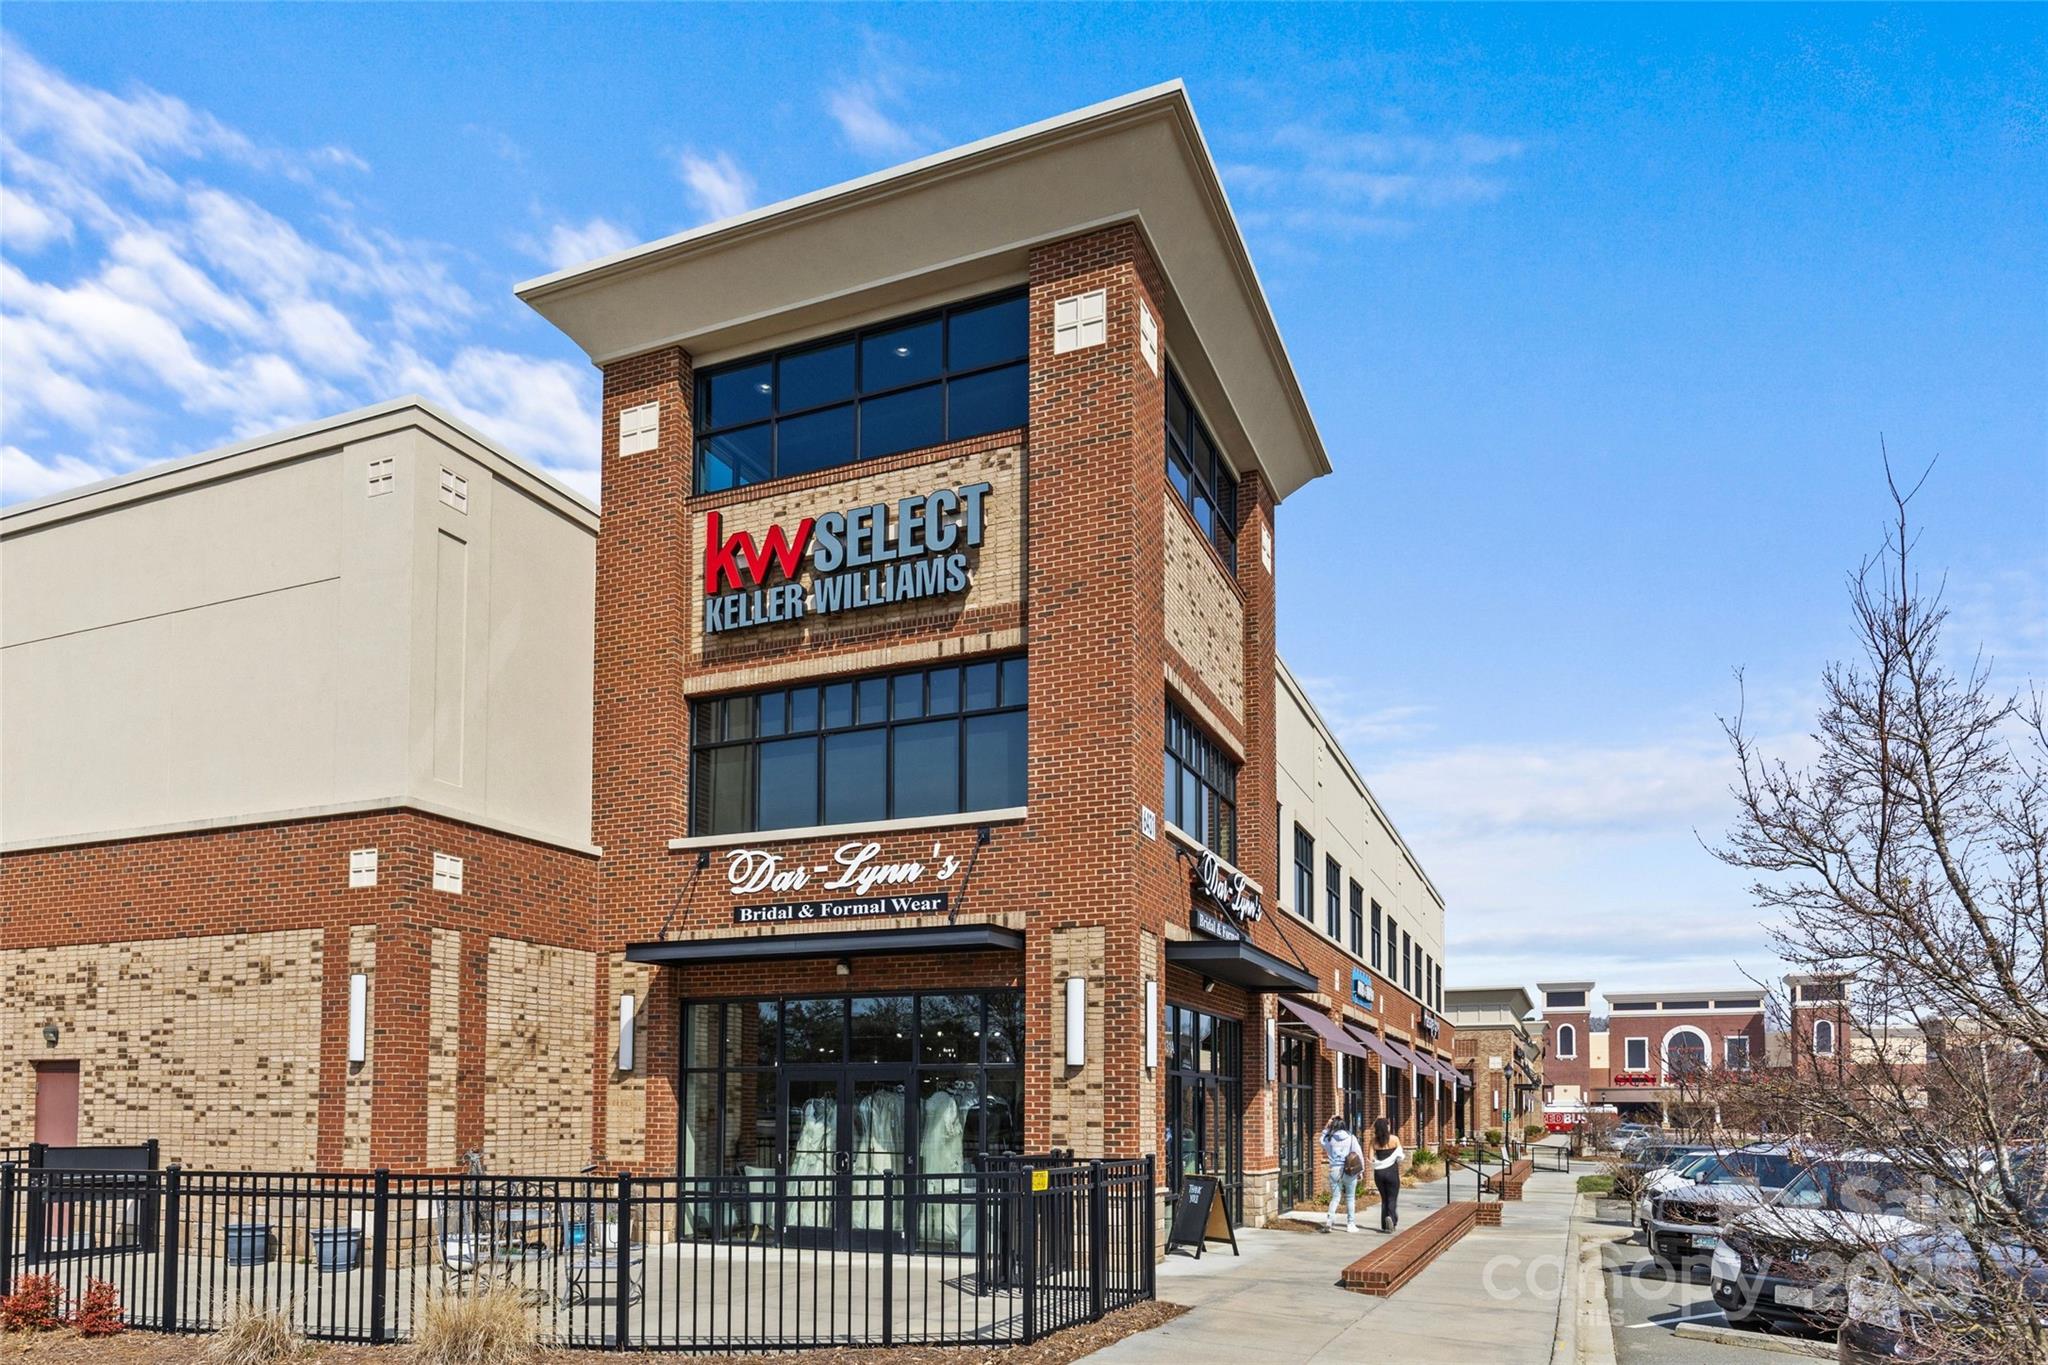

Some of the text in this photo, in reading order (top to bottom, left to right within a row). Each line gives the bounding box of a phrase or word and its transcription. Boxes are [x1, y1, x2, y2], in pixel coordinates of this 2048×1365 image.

[706, 482, 991, 596] kw SELECT
[706, 553, 970, 634] KELLER WILLIAMS
[726, 842, 961, 896] Dar-Lynn's
[739, 896, 942, 923] Bridal & Formal Wear
[1199, 913, 1216, 933] Bridal
